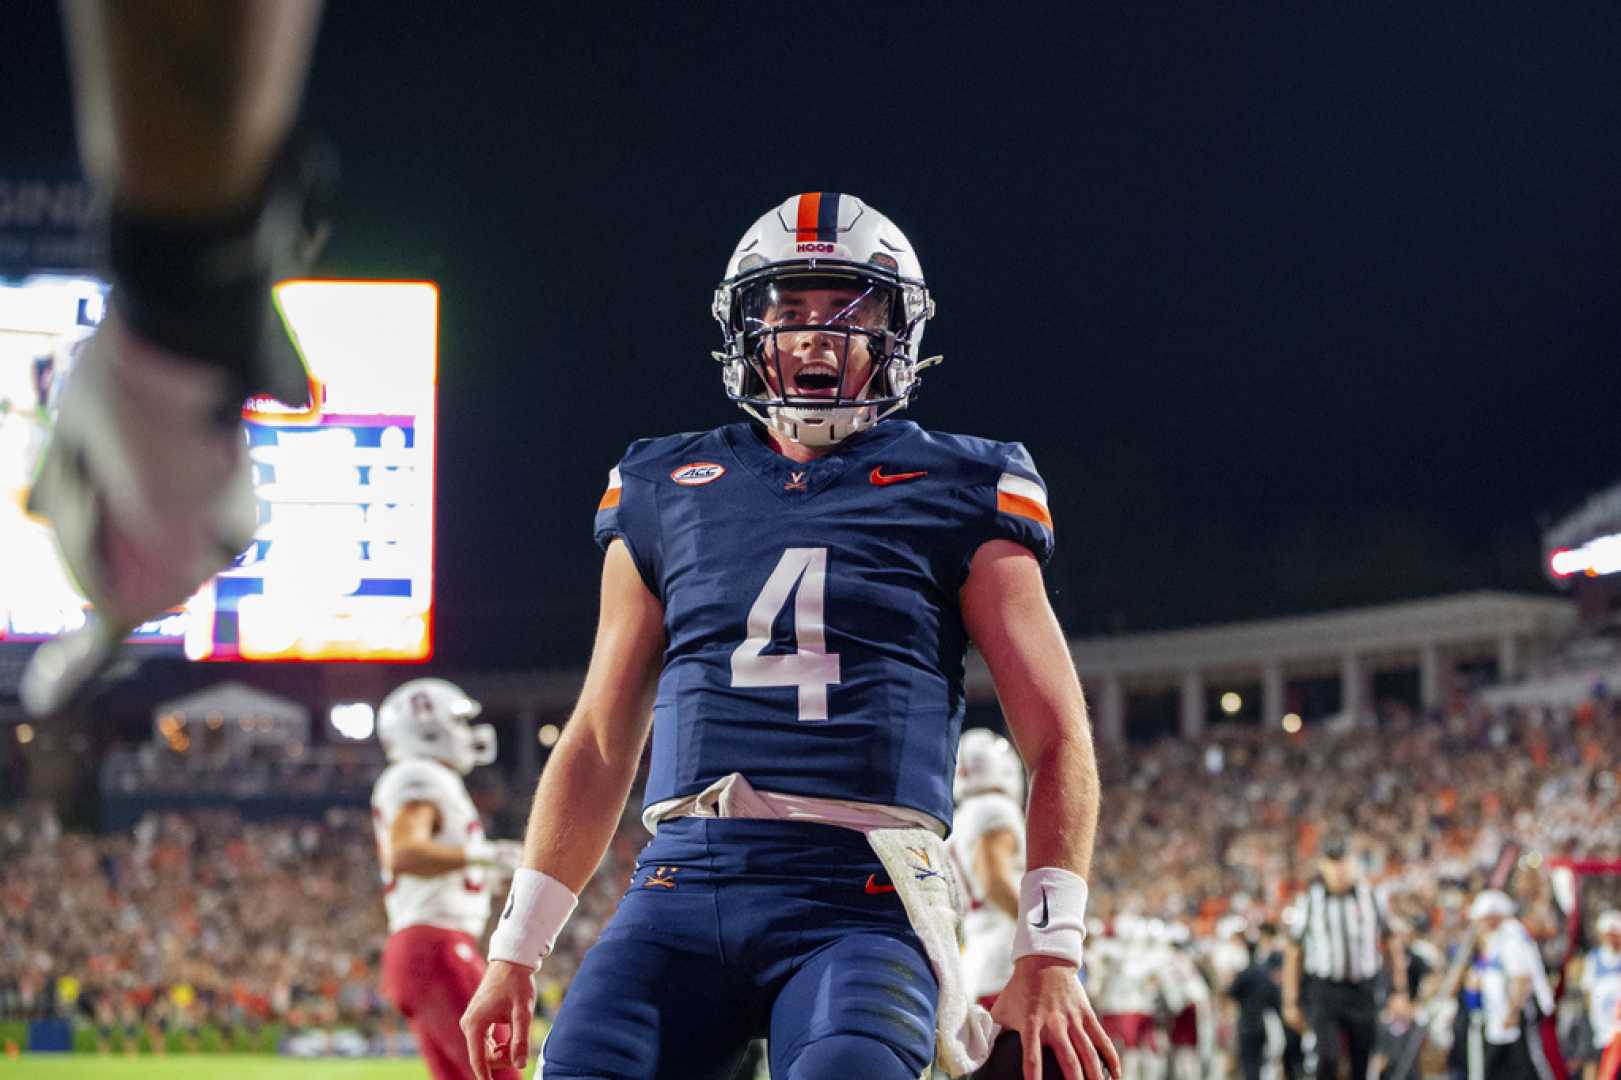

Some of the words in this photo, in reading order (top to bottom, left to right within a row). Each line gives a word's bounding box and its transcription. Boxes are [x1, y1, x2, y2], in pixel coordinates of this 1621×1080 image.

[797, 243, 834, 253] HOOS
[680, 466, 719, 479] ACC
[730, 547, 840, 721] 4
